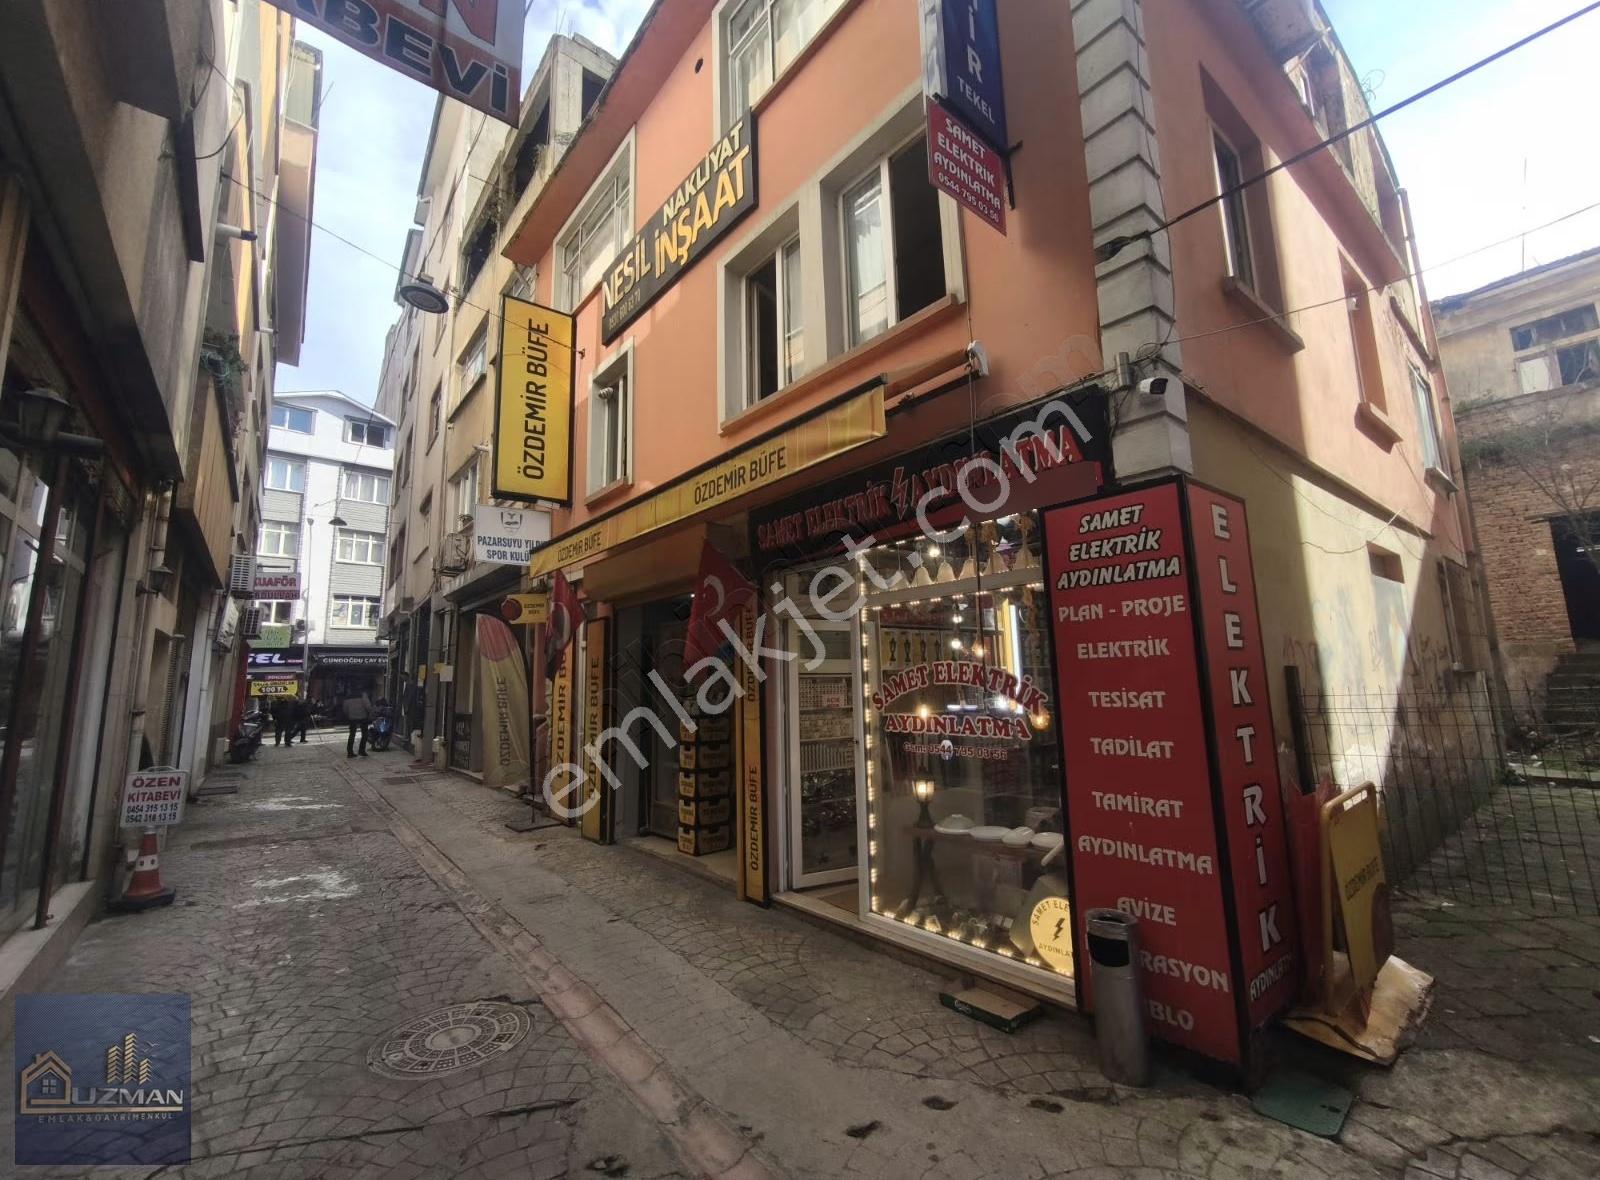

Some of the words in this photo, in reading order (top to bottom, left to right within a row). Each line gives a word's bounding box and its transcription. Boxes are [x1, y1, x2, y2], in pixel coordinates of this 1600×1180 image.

[296, 0, 509, 114] BEVİ
[956, 75, 996, 125] TEKEL
[945, 117, 986, 160] SAMET
[662, 120, 745, 226] NAKLİYAT
[937, 131, 996, 188] ELEKTRİK
[933, 151, 1001, 210] AYDINLATMA
[602, 231, 652, 318] NESİL
[654, 145, 750, 279] İNŞAAT
[521, 318, 550, 379] BÜFE
[517, 380, 548, 480] ÖZDEMİR
[694, 465, 746, 505] ÖZDEMİR
[749, 446, 786, 482] BÜFE
[1079, 503, 1145, 534] SAMET
[477, 535, 523, 549] PAZARSUYU
[486, 549, 508, 561] SPOR
[556, 539, 584, 563] ÖZDEMİR
[584, 531, 603, 552] BÜFE
[1068, 526, 1163, 562] ELEKTRİK
[1056, 556, 1181, 590] AYDINLATMA
[1057, 603, 1103, 623] PLAN
[1121, 594, 1186, 617] PROJE
[1077, 635, 1170, 659] ELEKTRİK
[872, 664, 929, 712] SAMET
[933, 660, 1049, 716] ELEKTRİK
[1088, 687, 1167, 710] TESİSAT
[885, 713, 1033, 741] AYDINLATMA
[1211, 503, 1283, 953] ELEKTRİK
[1089, 735, 1174, 759] TADİLAT
[127, 788, 182, 803] KİTABEVİ
[131, 776, 181, 789] ÖZEN
[1091, 791, 1184, 819] TAMİRAT
[1078, 835, 1213, 876] AYDINLATMA
[1032, 901, 1051, 926] SAMET
[1053, 899, 1070, 912] ELE
[1116, 896, 1177, 927] AVİZE
[1137, 949, 1230, 994] RASYON
[1146, 997, 1195, 1031] BLO
